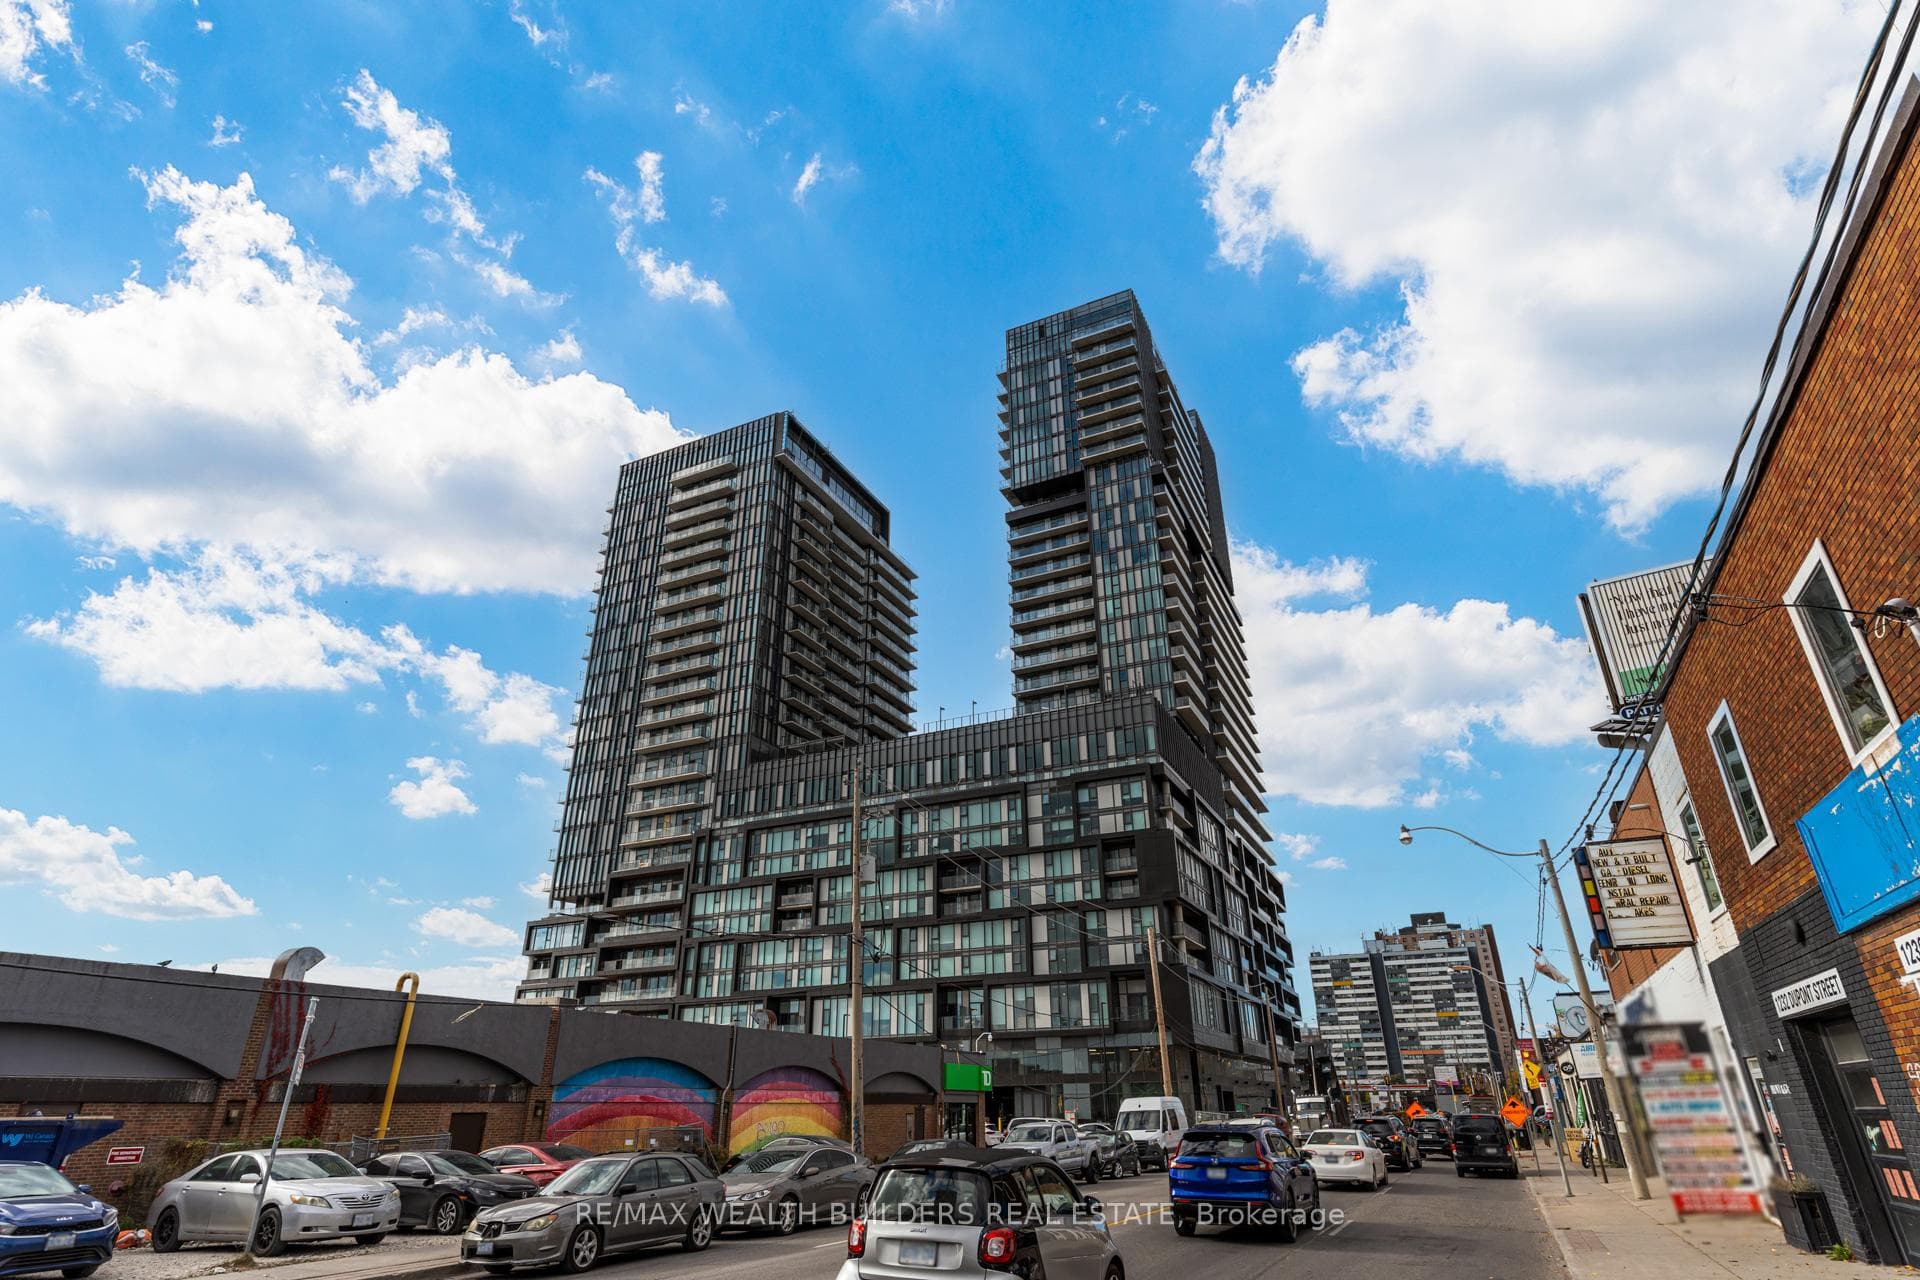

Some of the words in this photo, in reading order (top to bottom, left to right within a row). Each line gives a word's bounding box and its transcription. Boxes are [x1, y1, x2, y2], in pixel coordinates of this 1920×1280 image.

[1592, 859, 1608, 868] NEW
[1639, 896, 1670, 906] REPAIR
[1900, 936, 1920, 966] 123
[1775, 994, 1790, 1012] 1232
[1787, 984, 1815, 1008] DUPONT
[1812, 975, 1842, 1000] STREET
[981, 1070, 992, 1087] TD
